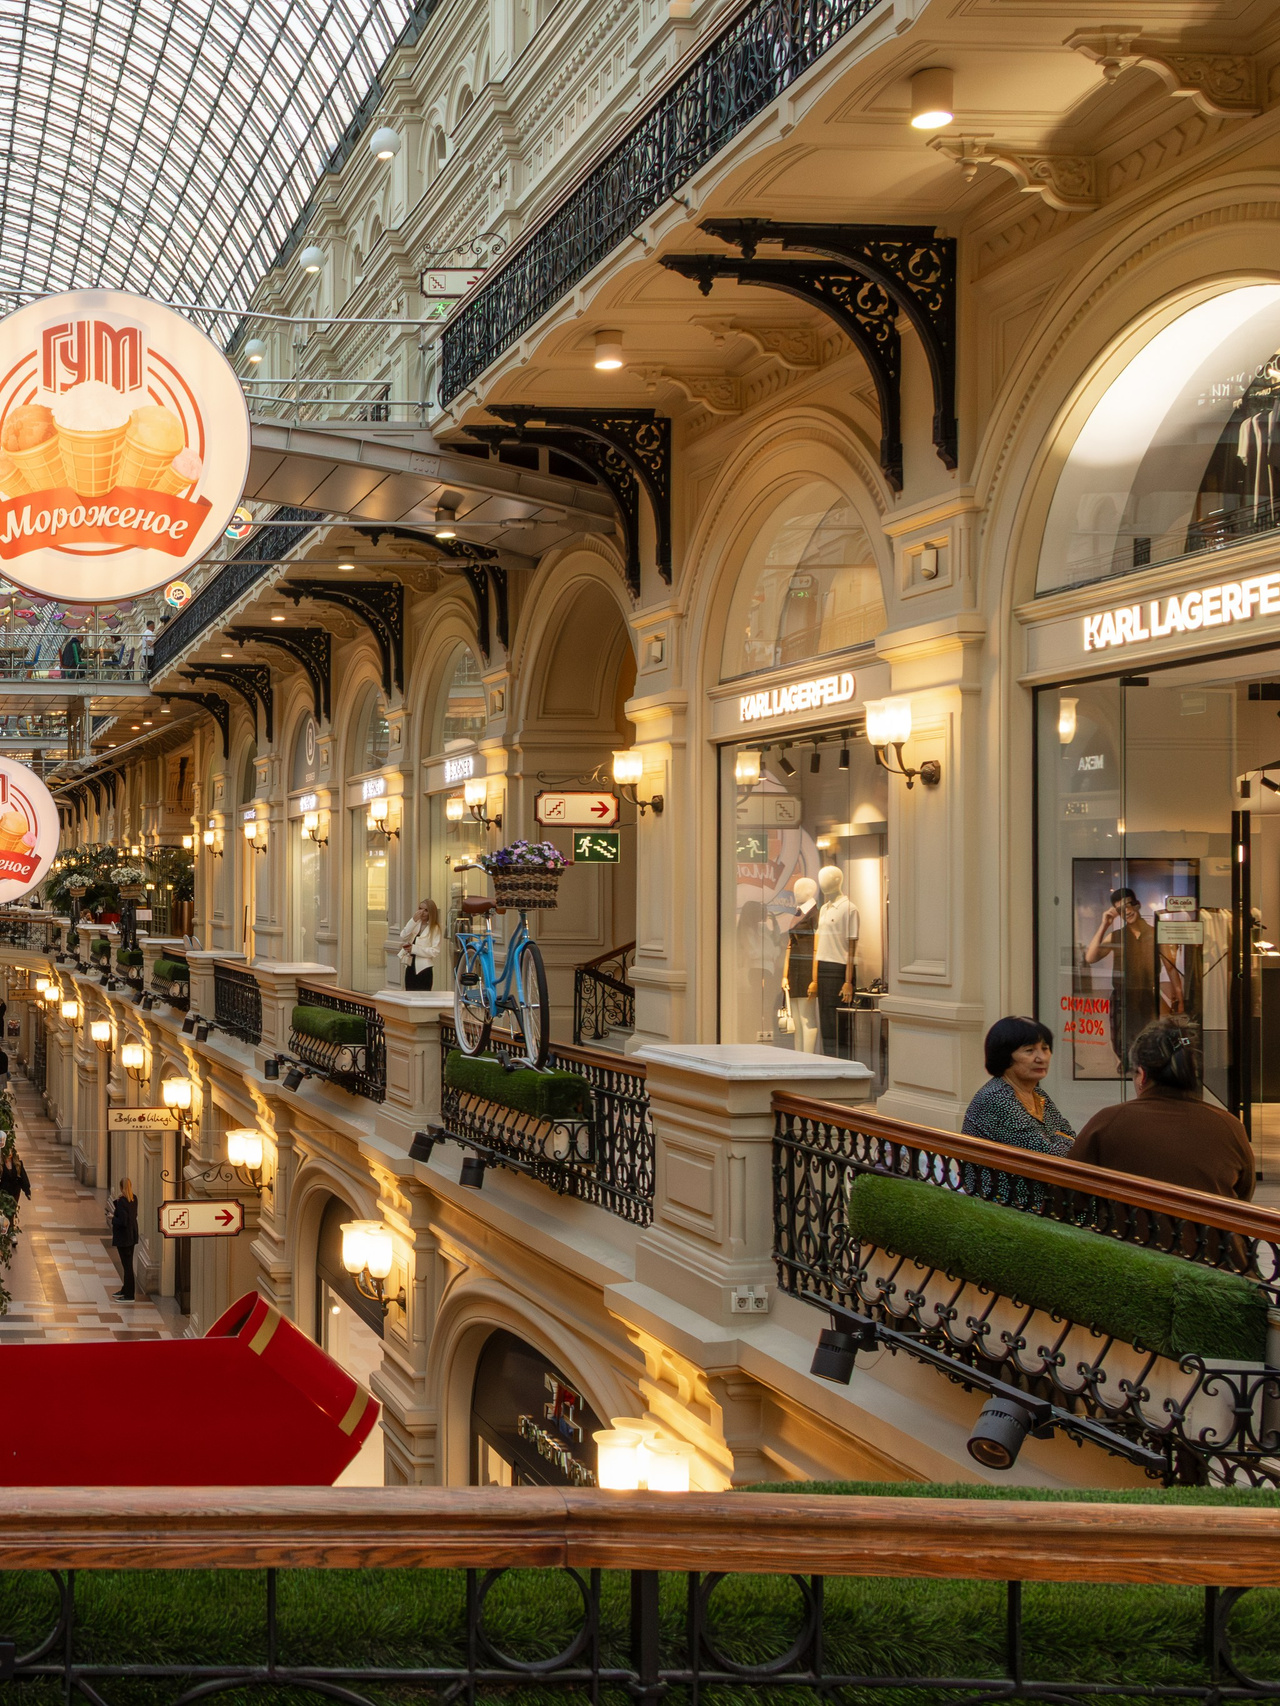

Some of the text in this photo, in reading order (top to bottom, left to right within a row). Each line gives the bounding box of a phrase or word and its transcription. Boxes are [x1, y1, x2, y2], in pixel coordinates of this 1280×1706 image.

[42, 320, 143, 396] ГУМ
[0, 504, 189, 544] Мороженое
[1084, 603, 1150, 651] KARL
[740, 673, 856, 721] KARL LAGERFELD
[1060, 996, 1110, 1015] СКИДКИ
[1078, 1018, 1105, 1036] 30%
